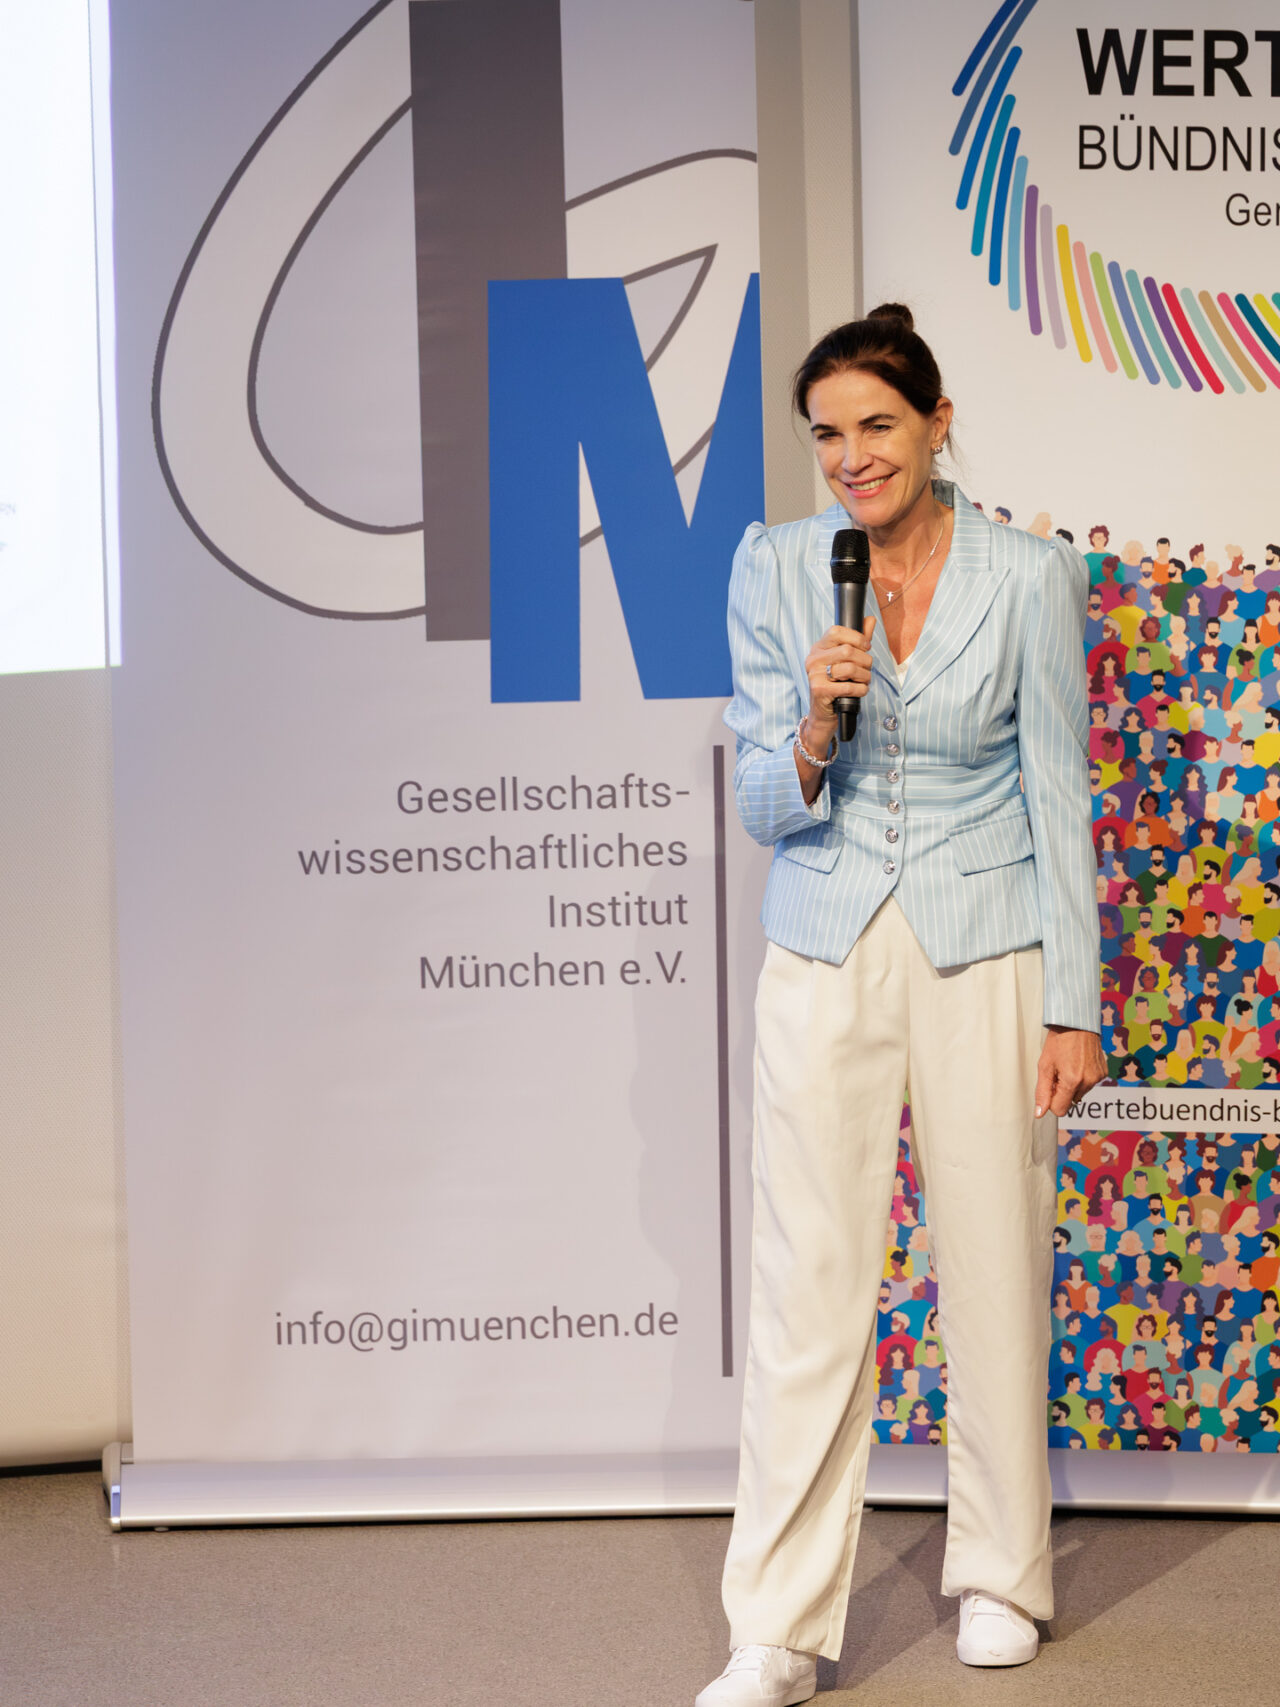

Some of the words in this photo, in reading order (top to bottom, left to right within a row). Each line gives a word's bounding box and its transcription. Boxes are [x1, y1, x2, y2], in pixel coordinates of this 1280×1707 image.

[397, 773, 689, 814] Gesellschafts-
[298, 833, 687, 875] wissenschaftliches
[550, 891, 688, 927] Institut
[420, 952, 604, 989] München
[620, 951, 685, 985] e.V.
[276, 1303, 678, 1352] info@gimuenchen.de
